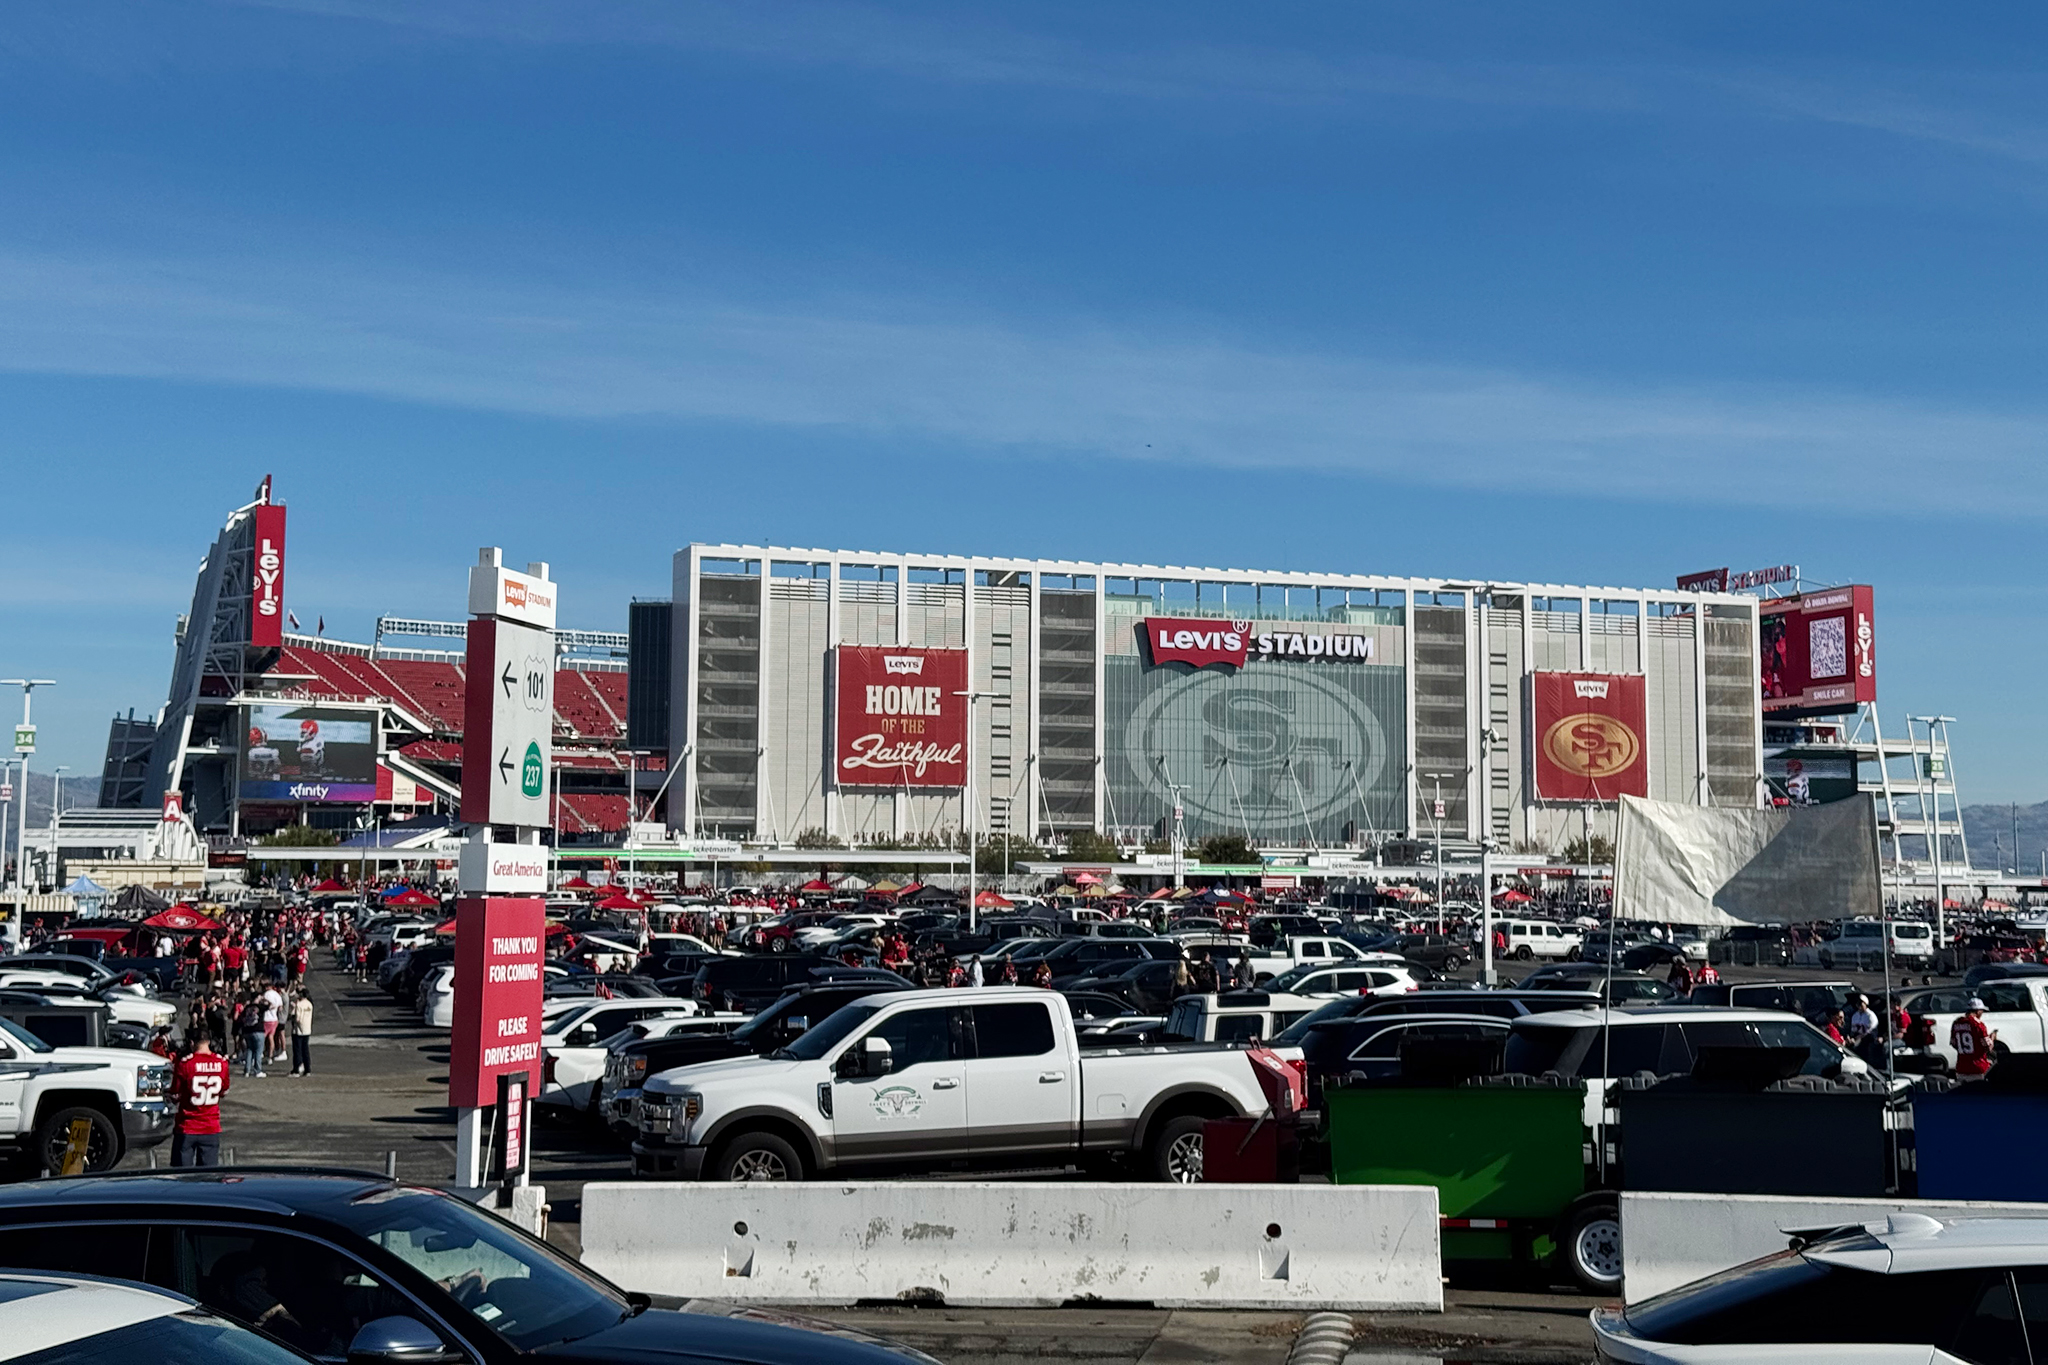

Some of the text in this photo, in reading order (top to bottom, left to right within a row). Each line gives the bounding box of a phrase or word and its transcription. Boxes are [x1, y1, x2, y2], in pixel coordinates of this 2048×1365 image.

[1731, 564, 1791, 589] STADIUM
[528, 592, 551, 608] STADIUM
[1258, 632, 1374, 658] STADIUM
[527, 671, 543, 700] 101
[865, 685, 941, 716] HOME
[881, 719, 925, 734] OF THE
[17, 733, 33, 744] 34
[843, 733, 962, 778] Faithful
[525, 765, 540, 787] 237
[289, 783, 329, 799] xfinity
[164, 800, 181, 818] A
[493, 860, 543, 877] Great America
[492, 937, 538, 955] THANK YOU
[489, 963, 539, 983] FOR COMING
[498, 1016, 528, 1037] PLEASE
[1955, 1032, 1975, 1054] 19
[484, 1042, 539, 1067] DRIVE SAFELY
[196, 1062, 222, 1073] WILLIS
[191, 1075, 223, 1106] 52
